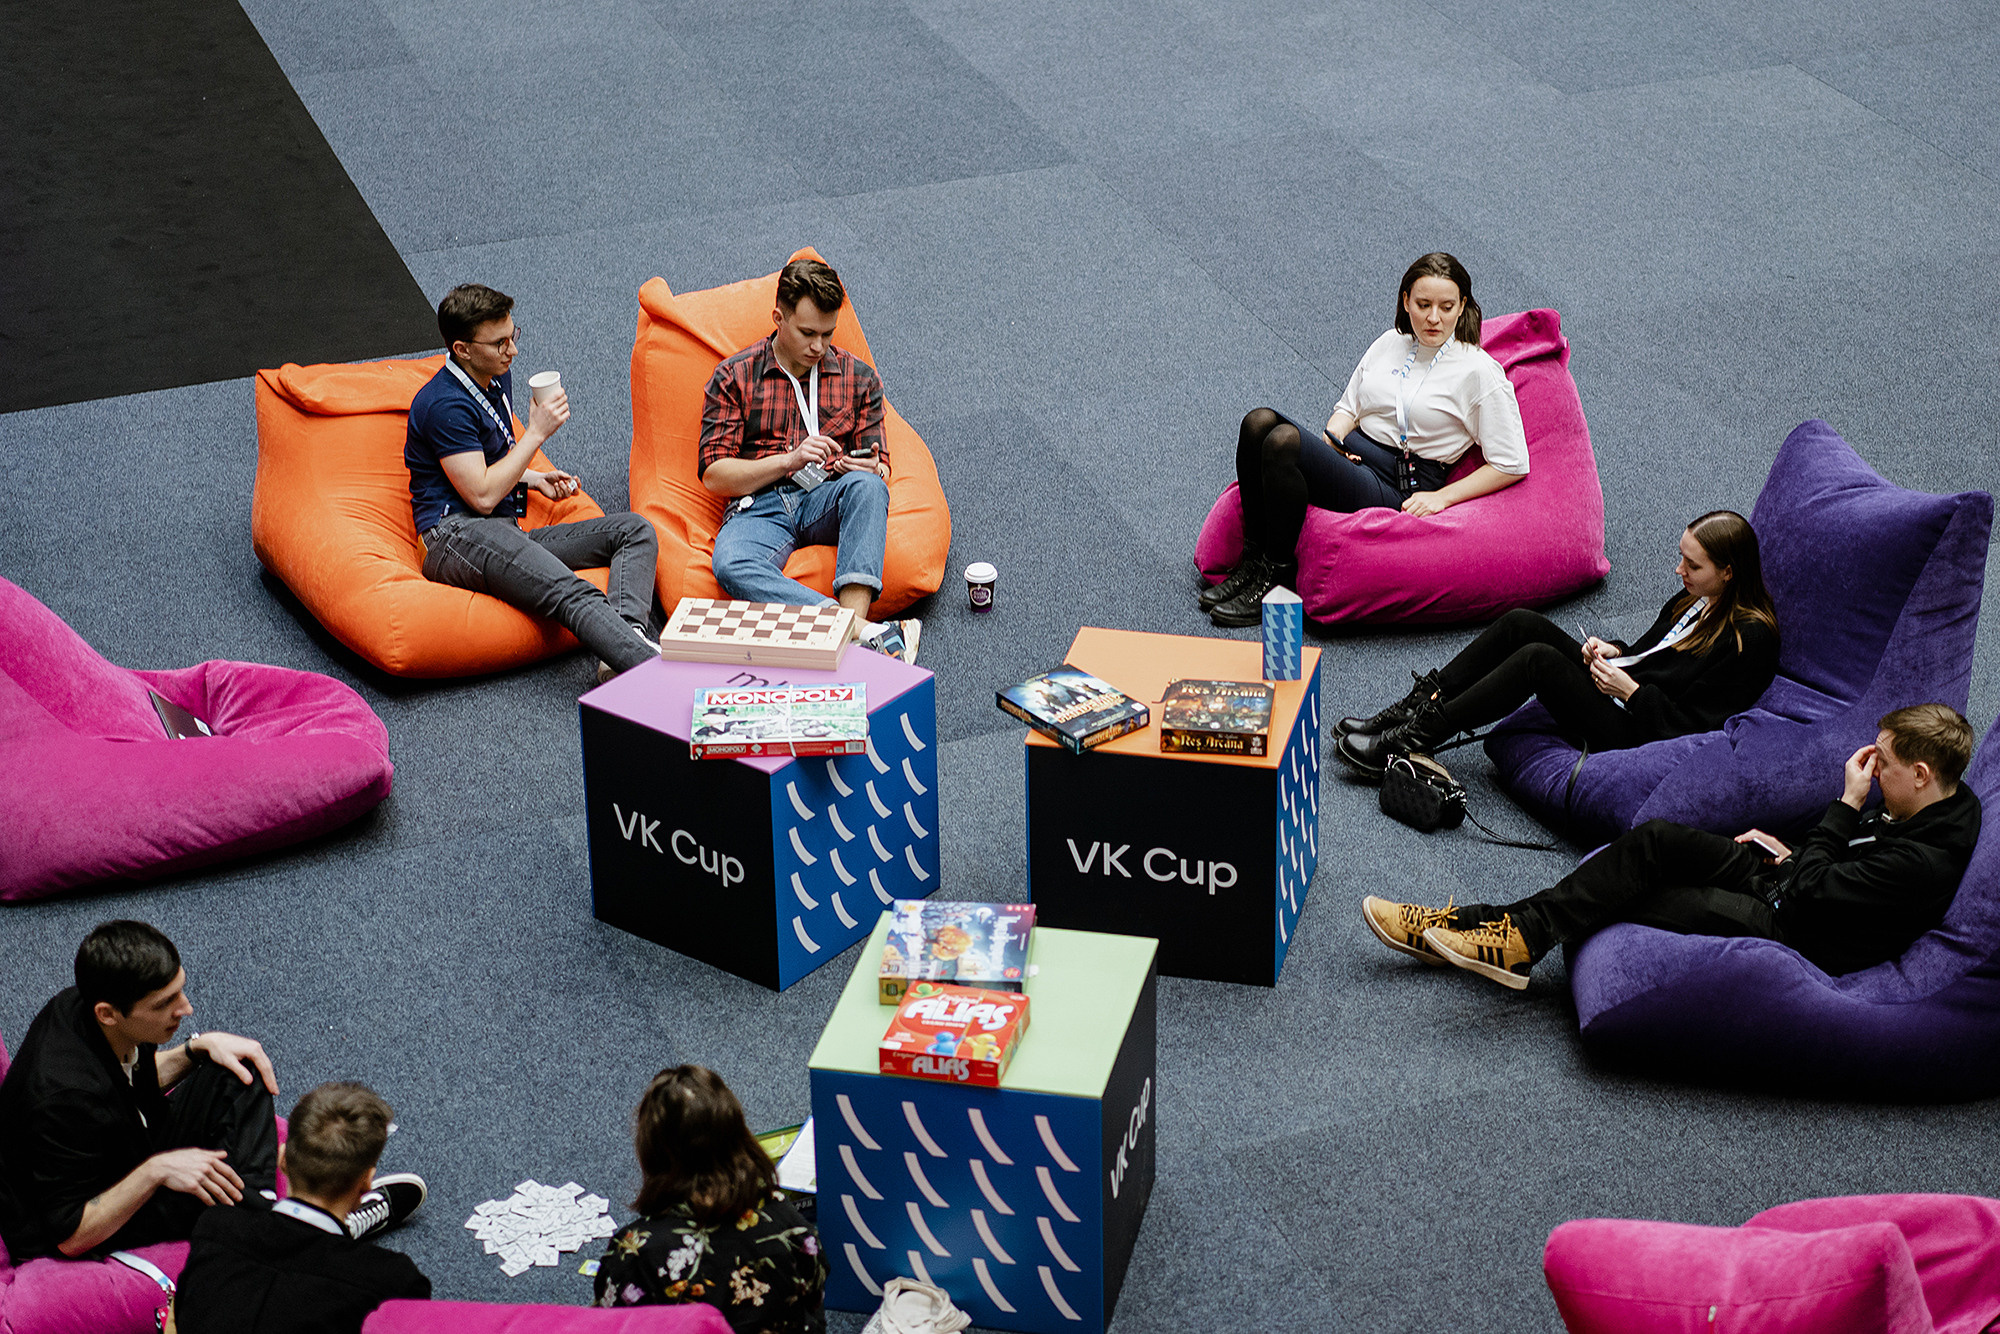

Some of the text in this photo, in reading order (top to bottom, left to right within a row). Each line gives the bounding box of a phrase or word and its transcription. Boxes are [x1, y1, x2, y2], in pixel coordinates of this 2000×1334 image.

[710, 688, 851, 705] MONOPOLY
[1181, 684, 1210, 696] Res
[709, 745, 745, 753] MONOPOLY
[1180, 734, 1202, 747] Res
[1203, 735, 1244, 750] Arcana
[613, 803, 745, 888] VK Cup
[1067, 838, 1238, 895] VK Cup
[904, 998, 1015, 1031] ALIAS
[912, 1055, 970, 1081] ALIAS
[1110, 1077, 1151, 1199] VK Cup
